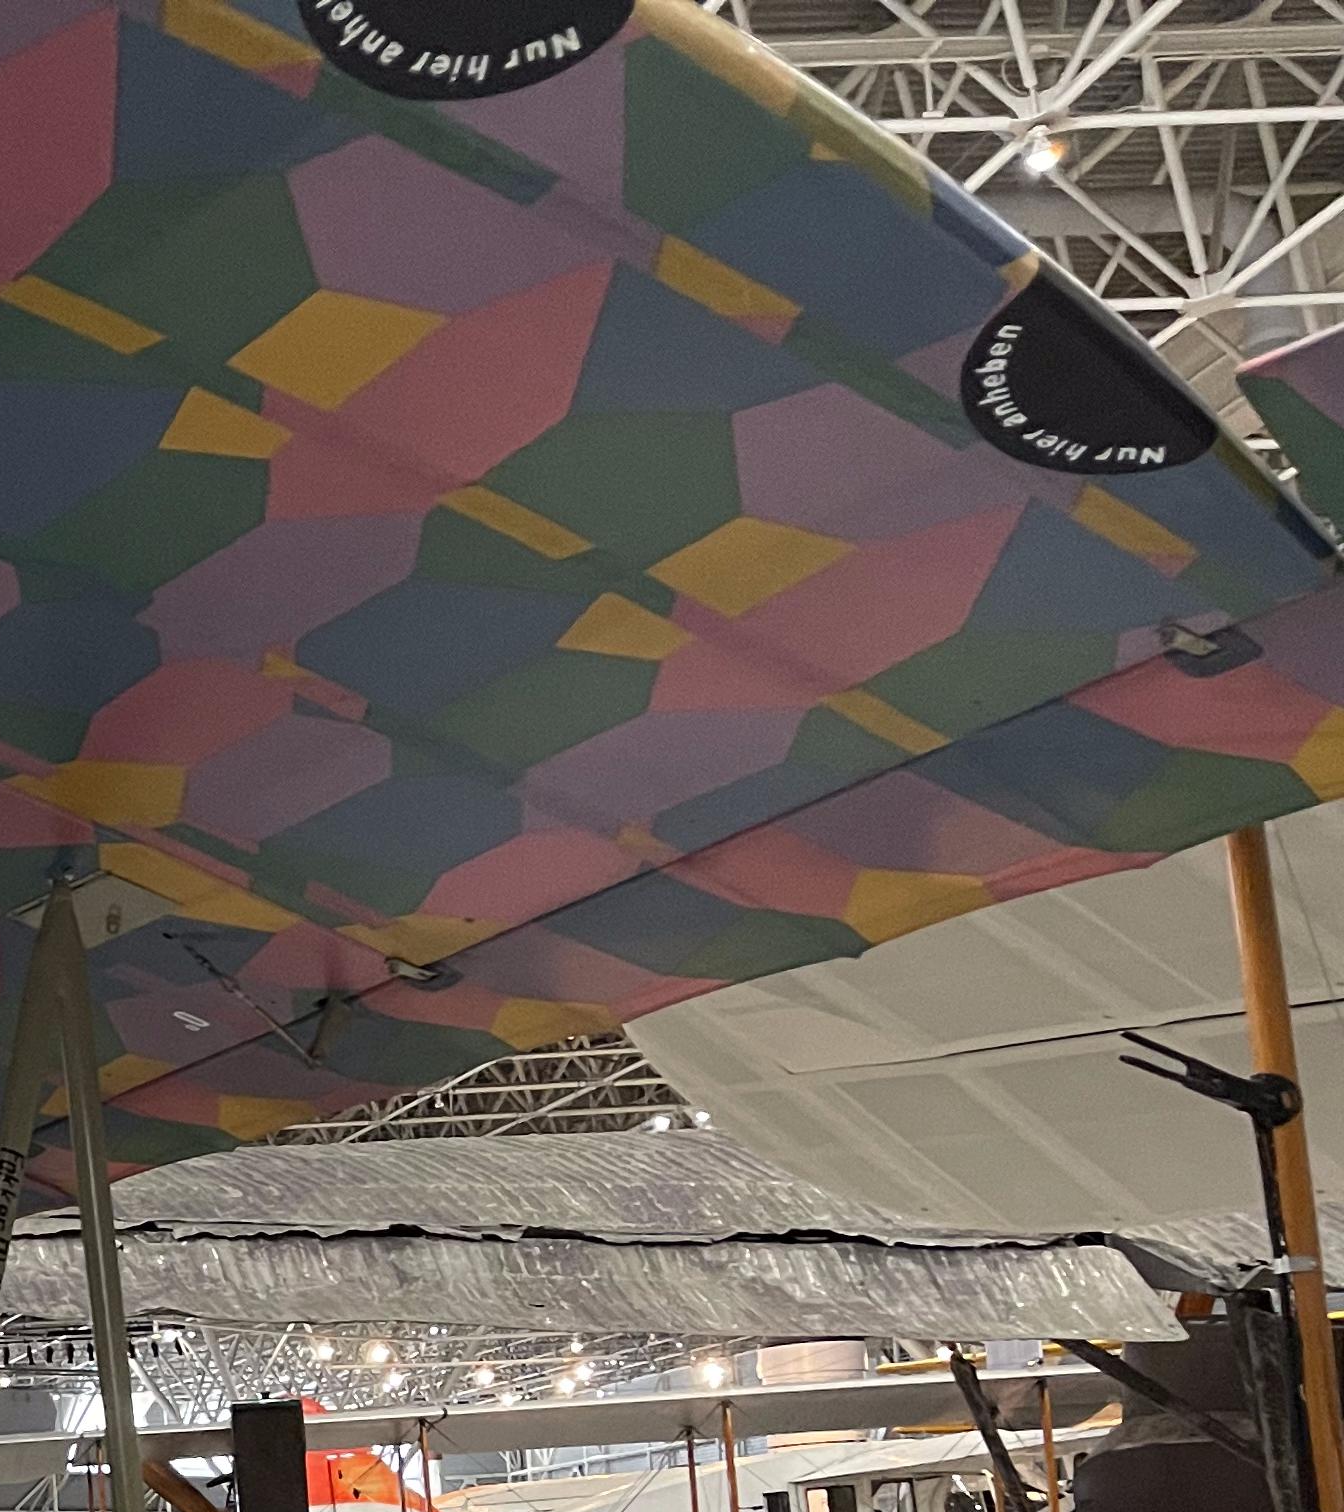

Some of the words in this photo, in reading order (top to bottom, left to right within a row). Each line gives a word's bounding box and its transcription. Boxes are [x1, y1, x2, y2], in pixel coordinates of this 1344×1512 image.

[503, 26, 581, 69] Nur
[409, 51, 490, 83] hier
[975, 324, 1028, 427] anheben
[1022, 428, 1088, 461] hier
[1095, 446, 1166, 465] Nur
